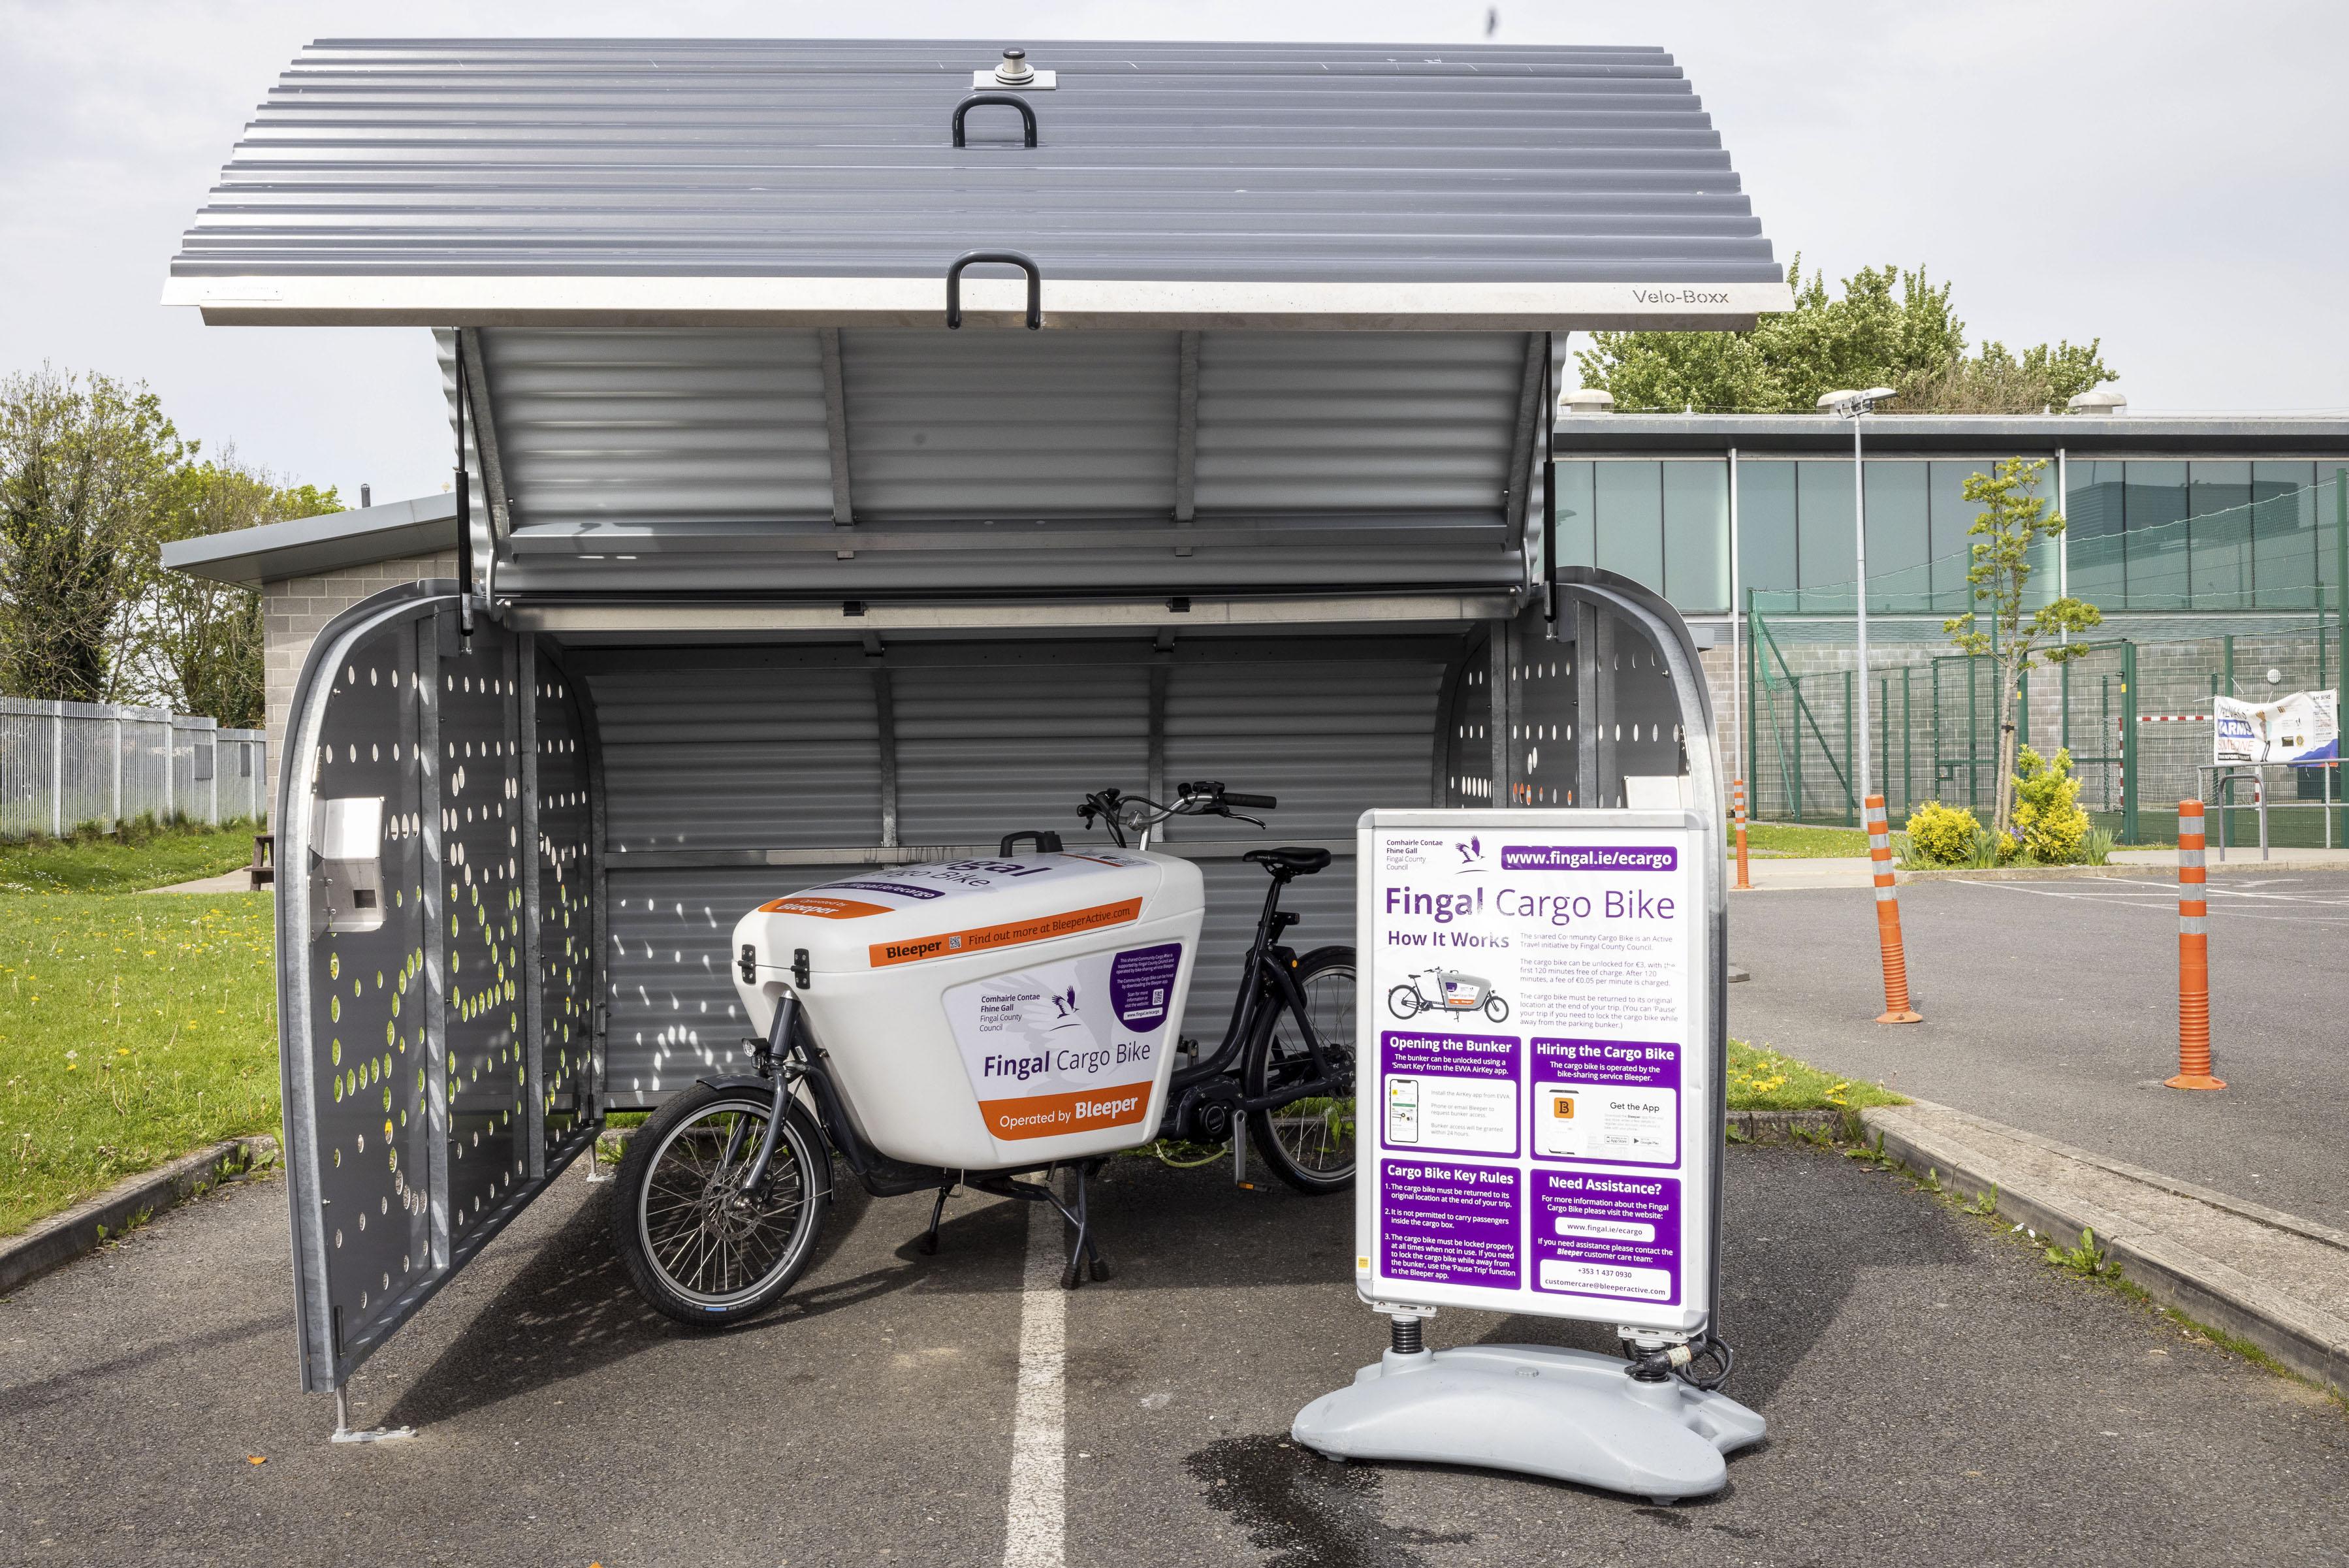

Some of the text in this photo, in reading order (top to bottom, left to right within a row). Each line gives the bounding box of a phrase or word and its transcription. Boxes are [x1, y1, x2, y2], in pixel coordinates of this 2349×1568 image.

[1633, 290, 1729, 303] Velo-Boxx
[1405, 856, 1426, 864] County
[1506, 851, 1672, 868] www.fingal.ie/ecargo
[776, 903, 839, 914] Bleeper
[1386, 886, 1674, 925] Fingal Cargo Bike
[969, 908, 1130, 945] Find out more at BleeperActive.com
[1388, 931, 1509, 947] How It Works
[886, 942, 941, 958] Bleeper
[980, 1014, 999, 1023] Fingal
[1390, 1036, 1512, 1052] Opening the Bunker
[1537, 1043, 1674, 1061] Hiring the Cargo Bike
[985, 1040, 1150, 1079] Fingal Cargo Bike
[1452, 1057, 1481, 1066] unlocked
[1482, 1058, 1500, 1066] using
[1472, 1066, 1493, 1074] AirKey
[1558, 1070, 1598, 1080] bike-sharing
[1624, 1073, 1652, 1082] Bleeper.
[1075, 1097, 1138, 1119] Bleeper
[1642, 1104, 1659, 1113] App
[1000, 1112, 1071, 1129] Operated by
[1388, 1164, 1513, 1184] Cargo Bike Key Rules
[1549, 1176, 1661, 1194] Need Assistance?
[1391, 1192, 1414, 1200] original
[1567, 1224, 1642, 1236] www.fingal.ie/ecargo
[1557, 1248, 1583, 1257] Bleeper
[1545, 1279, 1665, 1295] customercare@bleeperactive.com
